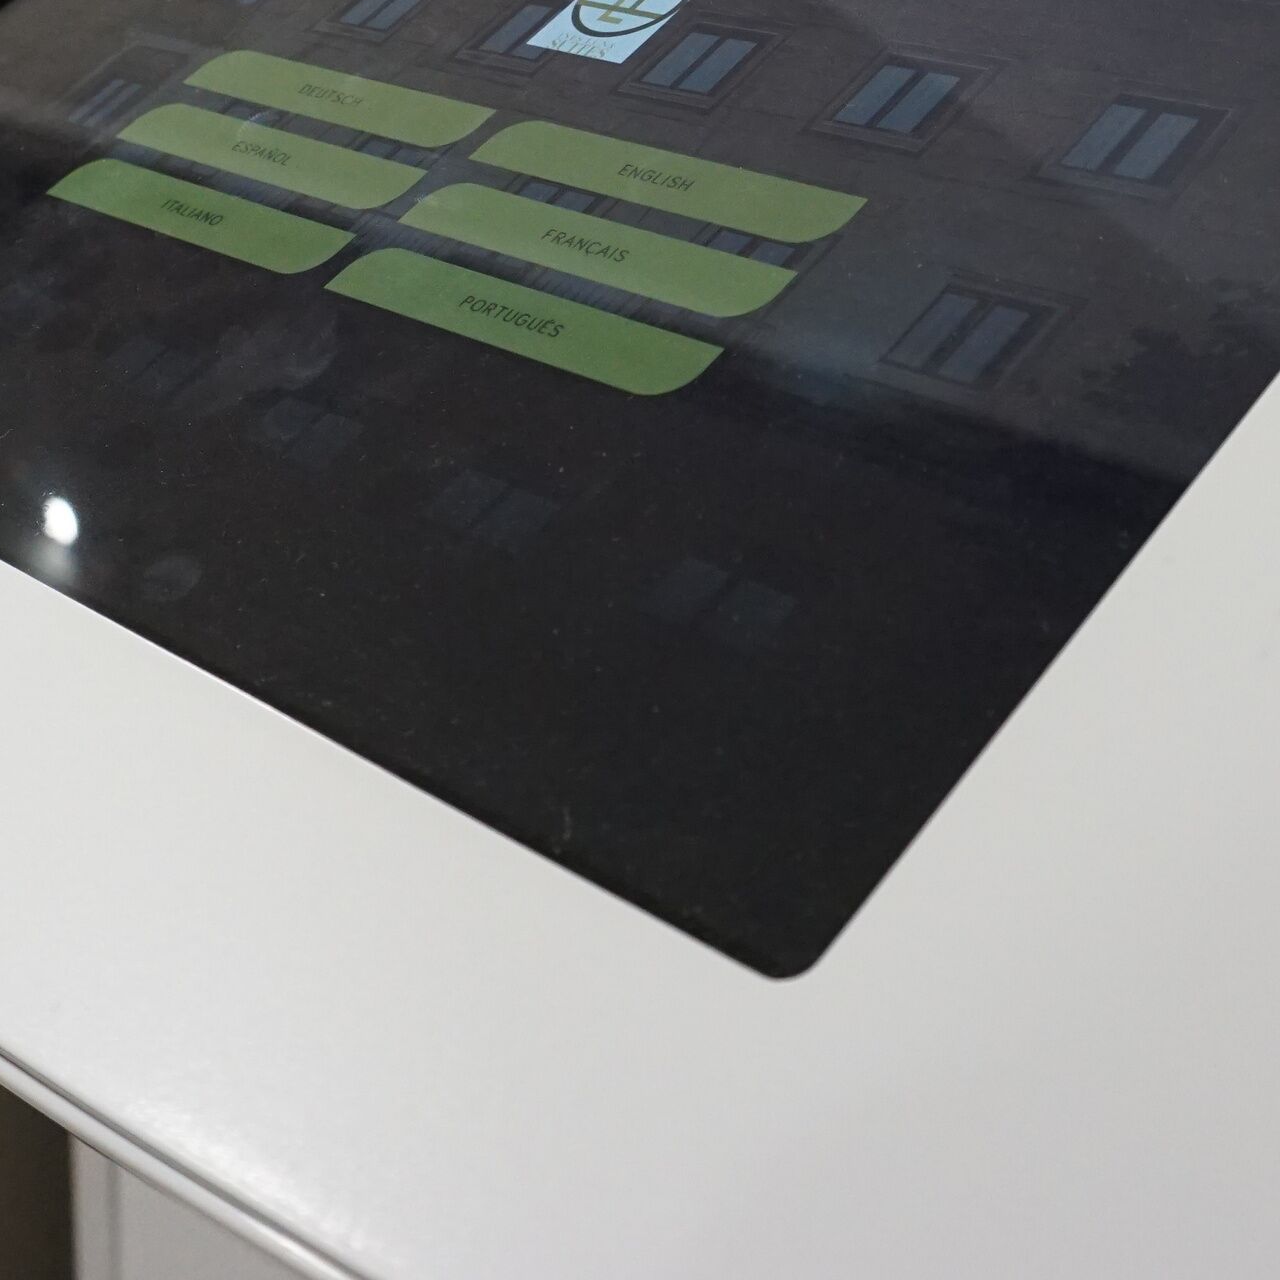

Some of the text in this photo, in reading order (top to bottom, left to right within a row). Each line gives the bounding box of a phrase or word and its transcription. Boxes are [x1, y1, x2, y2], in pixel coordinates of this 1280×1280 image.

[297, 84, 364, 106] DEUTSCH
[232, 140, 293, 166] ESPAÑOL
[618, 164, 695, 191] ENGLISH
[161, 199, 223, 226] ITALIANO
[541, 229, 630, 263] FRANÇAIS
